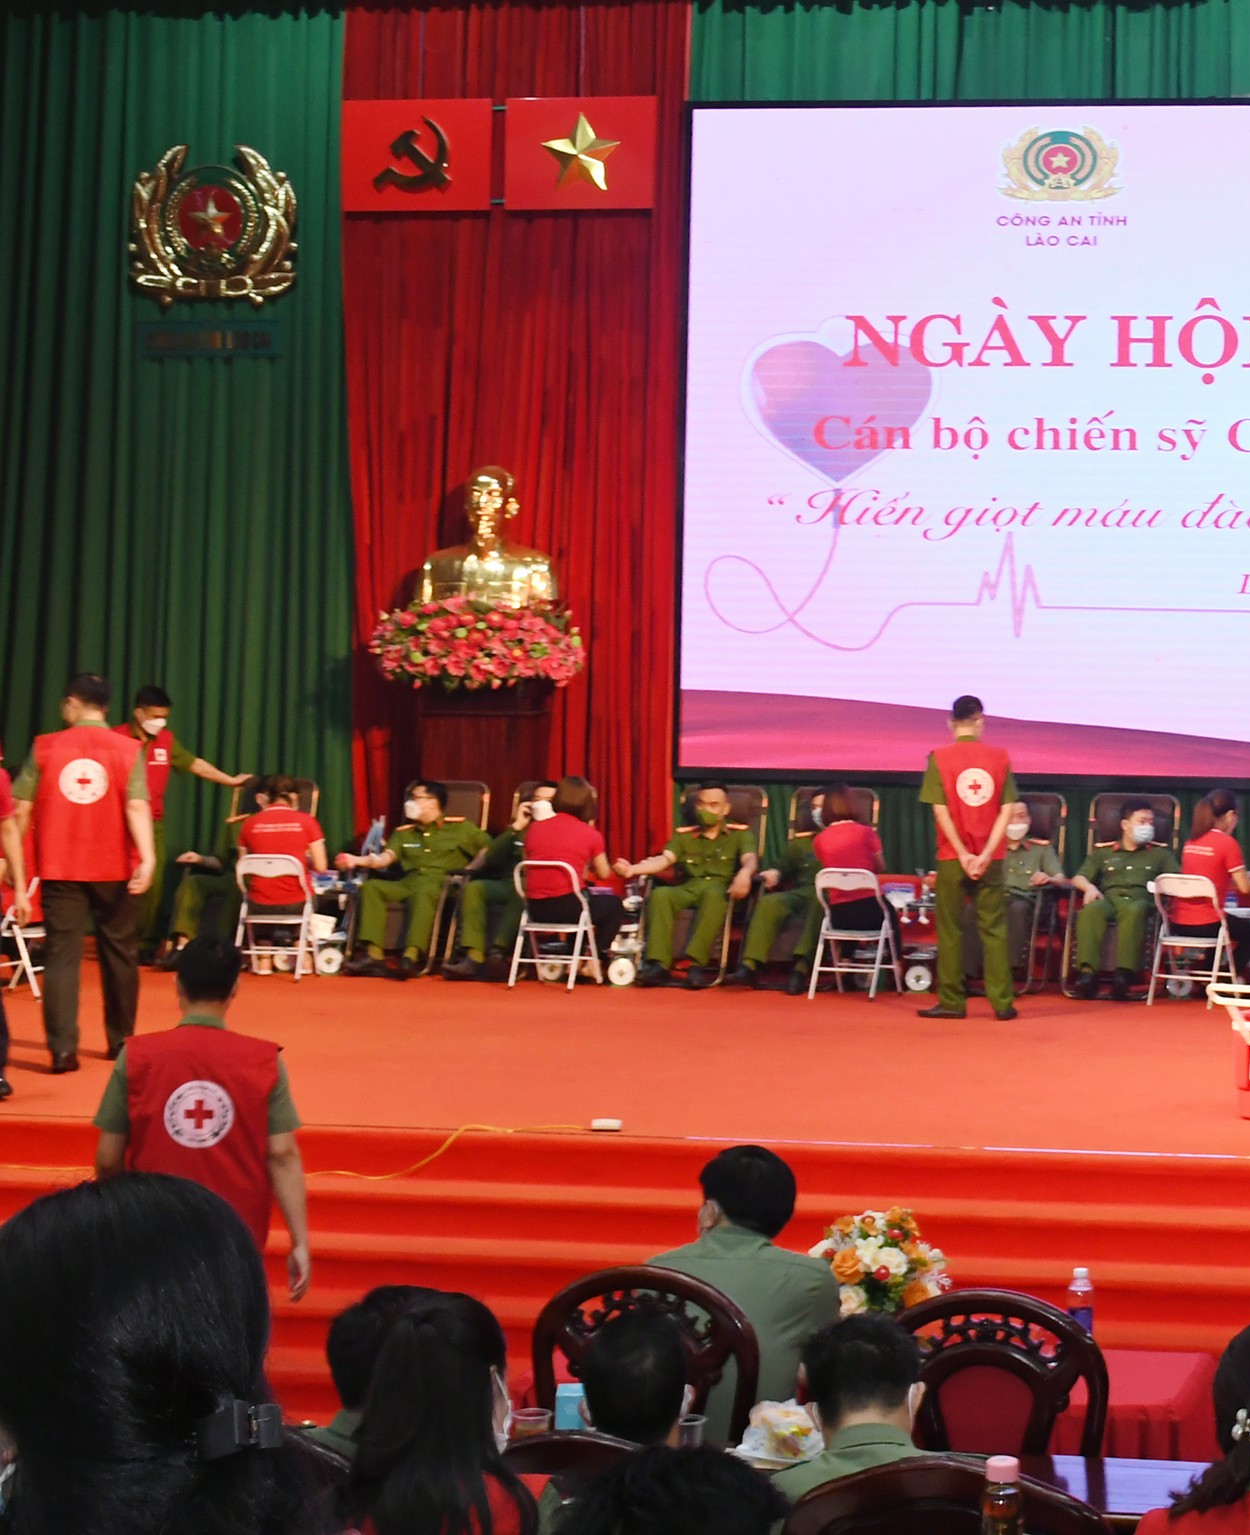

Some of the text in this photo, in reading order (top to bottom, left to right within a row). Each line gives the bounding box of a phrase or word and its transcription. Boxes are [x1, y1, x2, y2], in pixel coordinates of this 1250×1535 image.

[996, 212, 1128, 227] CÔNG AN TỈNH
[1025, 232, 1098, 246] LÀO CAI
[843, 297, 1087, 368] NGÀY
[812, 415, 912, 450] Cán
[932, 416, 989, 460] bộ
[1008, 410, 1138, 451] chiến
[1157, 419, 1209, 461] sỹ
[795, 488, 929, 527] Hiến
[922, 496, 1044, 541] giọt
[1051, 498, 1165, 528] máu
